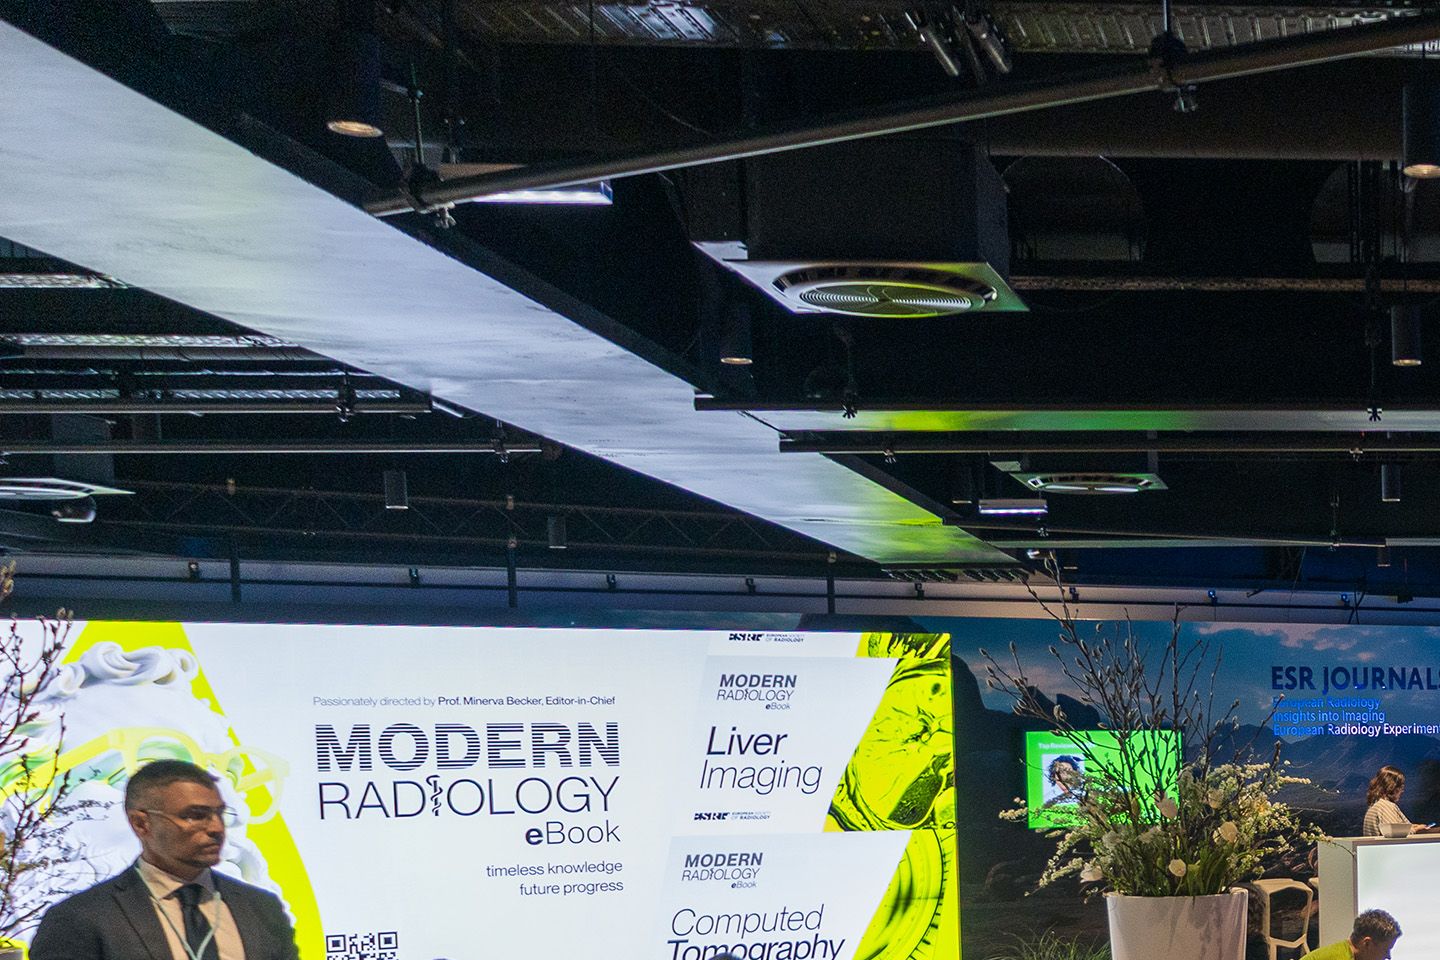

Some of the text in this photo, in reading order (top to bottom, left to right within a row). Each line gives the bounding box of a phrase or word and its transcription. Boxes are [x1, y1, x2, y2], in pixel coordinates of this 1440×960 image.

[719, 674, 798, 688] MODERN
[1271, 666, 1316, 690] ESR
[312, 695, 616, 708] Passionately directed by Prof. Minerva Becker, Editor-in-Chief
[716, 688, 794, 701] RADIOLOGY
[765, 702, 791, 710] eBook
[1327, 696, 1382, 709] Radiology
[1273, 710, 1386, 724] Insights into Imaging
[1273, 723, 1325, 737] European
[1328, 723, 1381, 737] Radiology
[315, 721, 621, 773] MODERN
[706, 726, 788, 756] Liver
[700, 759, 823, 795] Imaging
[318, 774, 620, 820] RADIOLOGY
[525, 820, 621, 846] eBook
[684, 852, 763, 868] MODERN
[486, 861, 623, 878] timeless knowledge
[681, 867, 760, 881] RADIOLOGY
[519, 881, 624, 896] future progress
[731, 881, 757, 889] eBook
[671, 903, 825, 939] Computed
